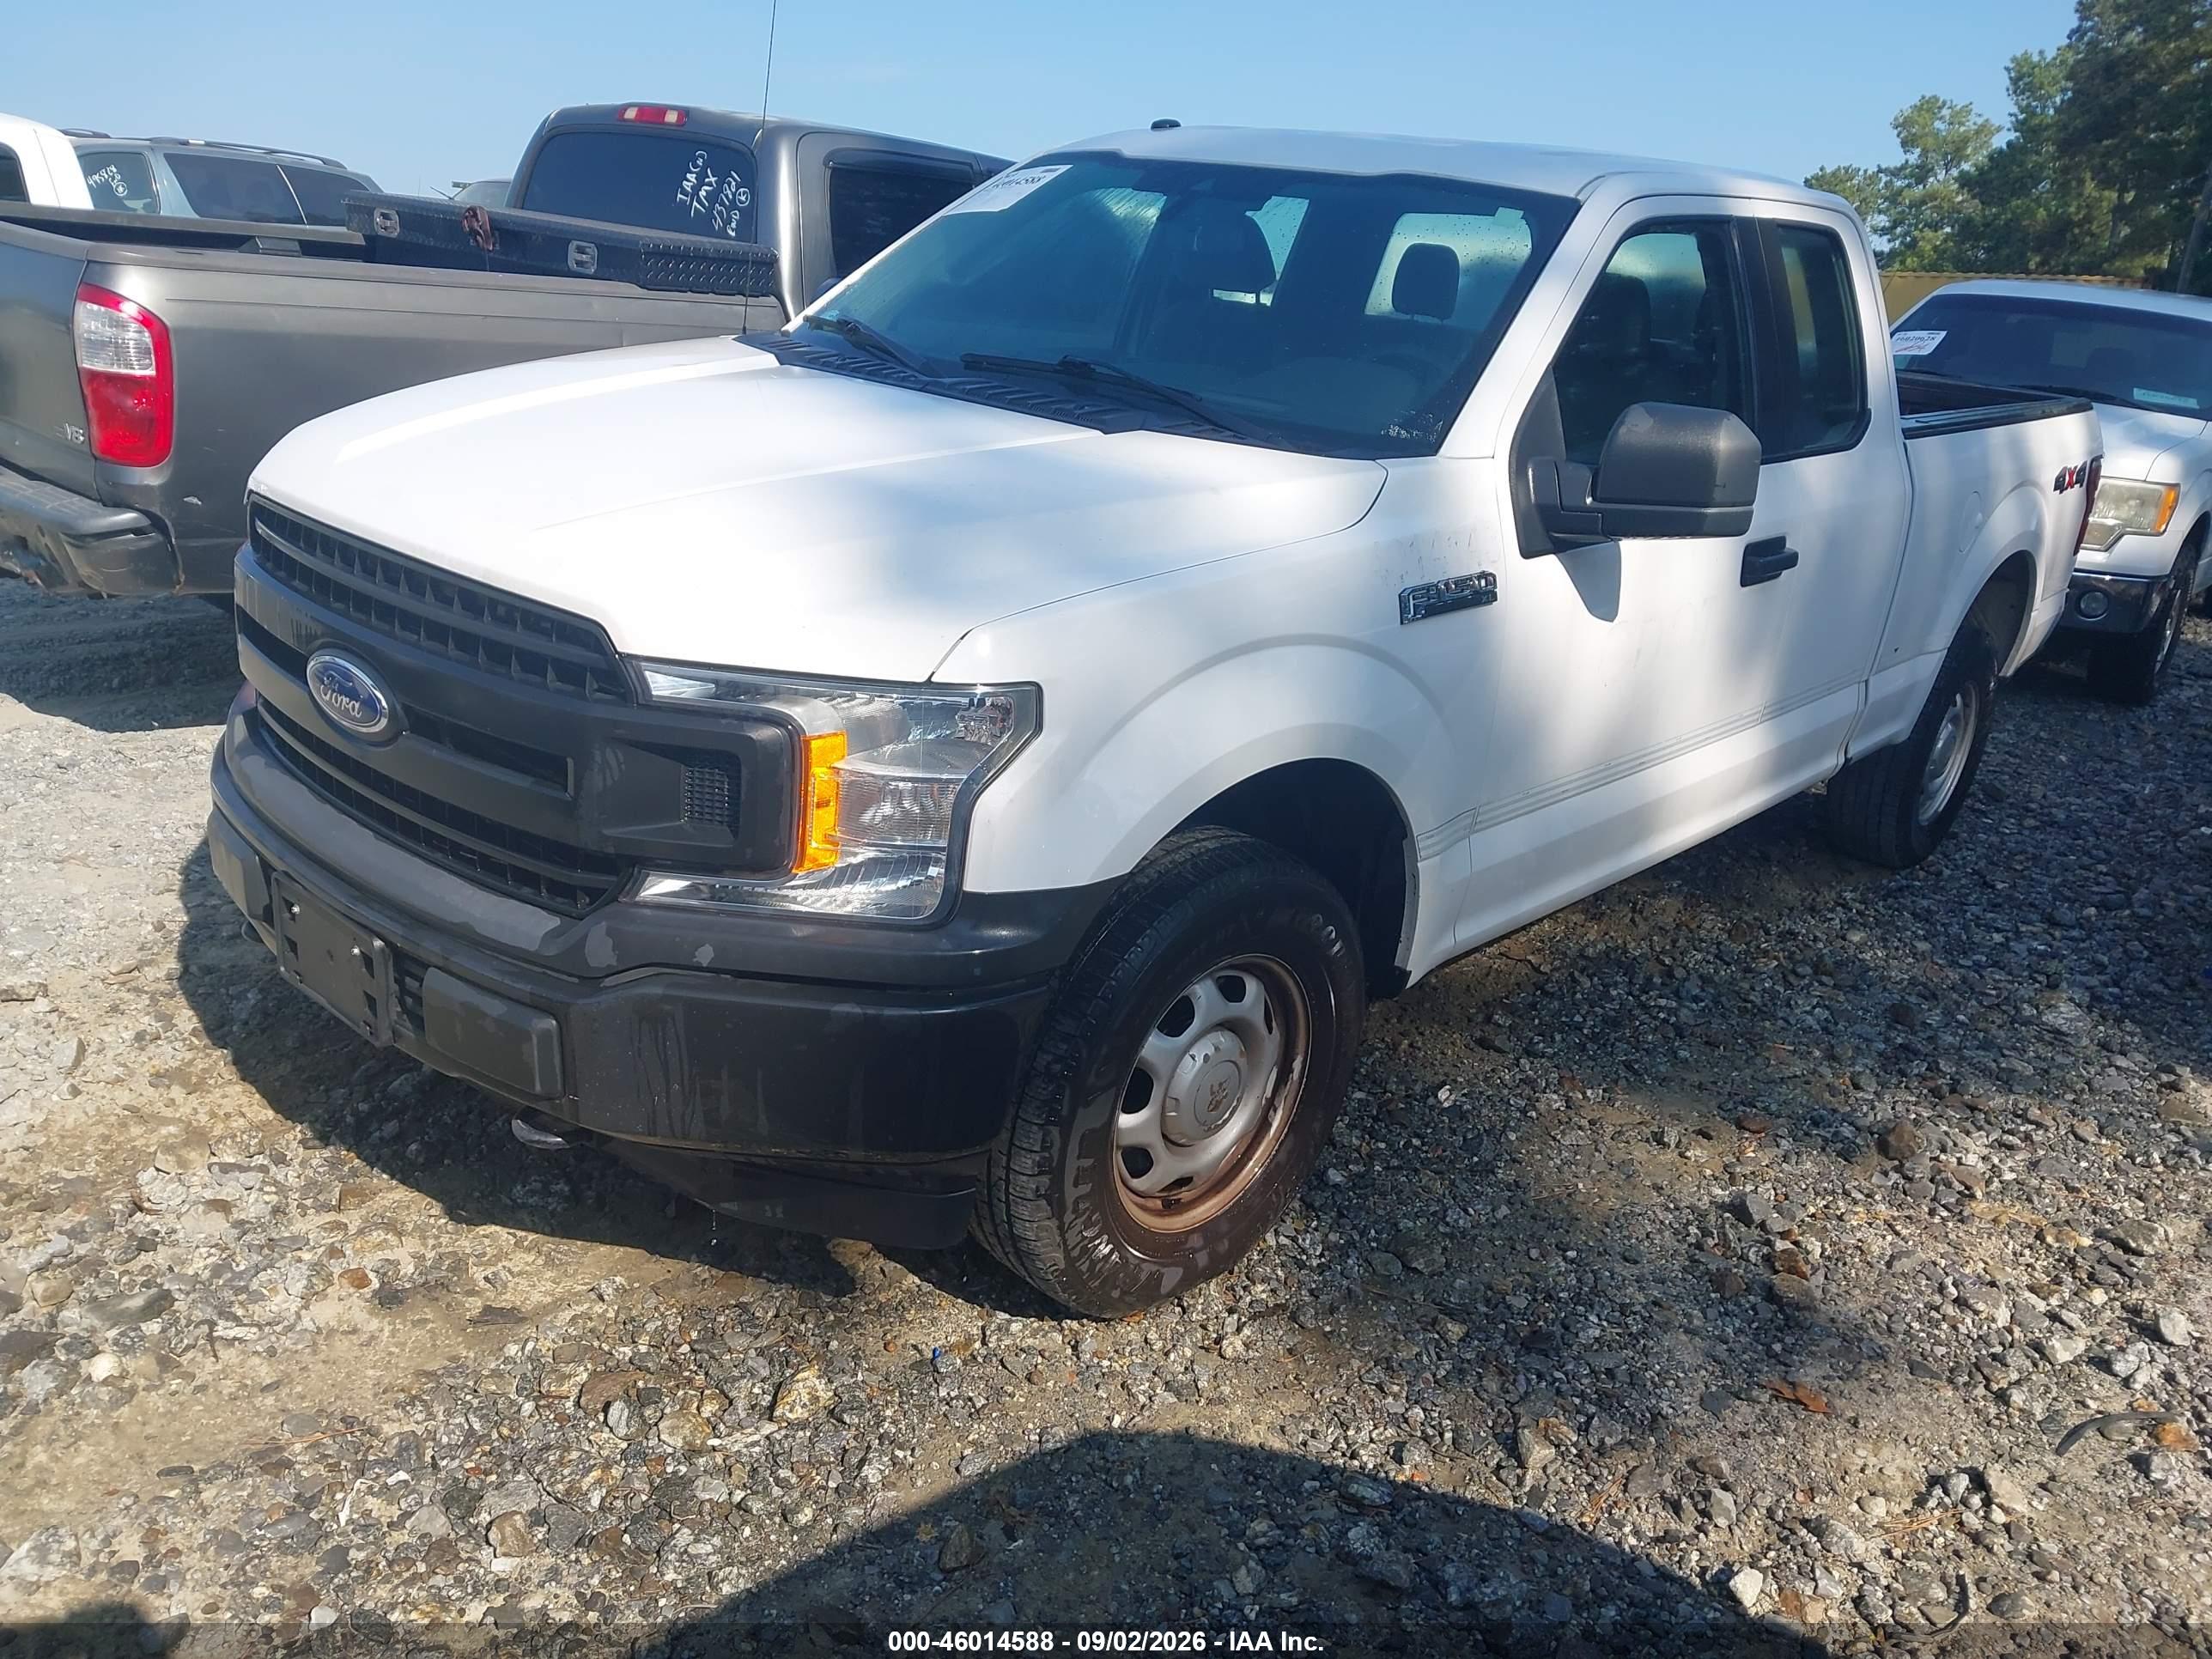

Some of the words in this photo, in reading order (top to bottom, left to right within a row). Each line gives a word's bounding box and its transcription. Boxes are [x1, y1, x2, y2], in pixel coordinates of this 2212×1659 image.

[690, 167, 719, 218] TMX
[711, 170, 742, 232] 437821
[319, 670, 362, 718] Ford
